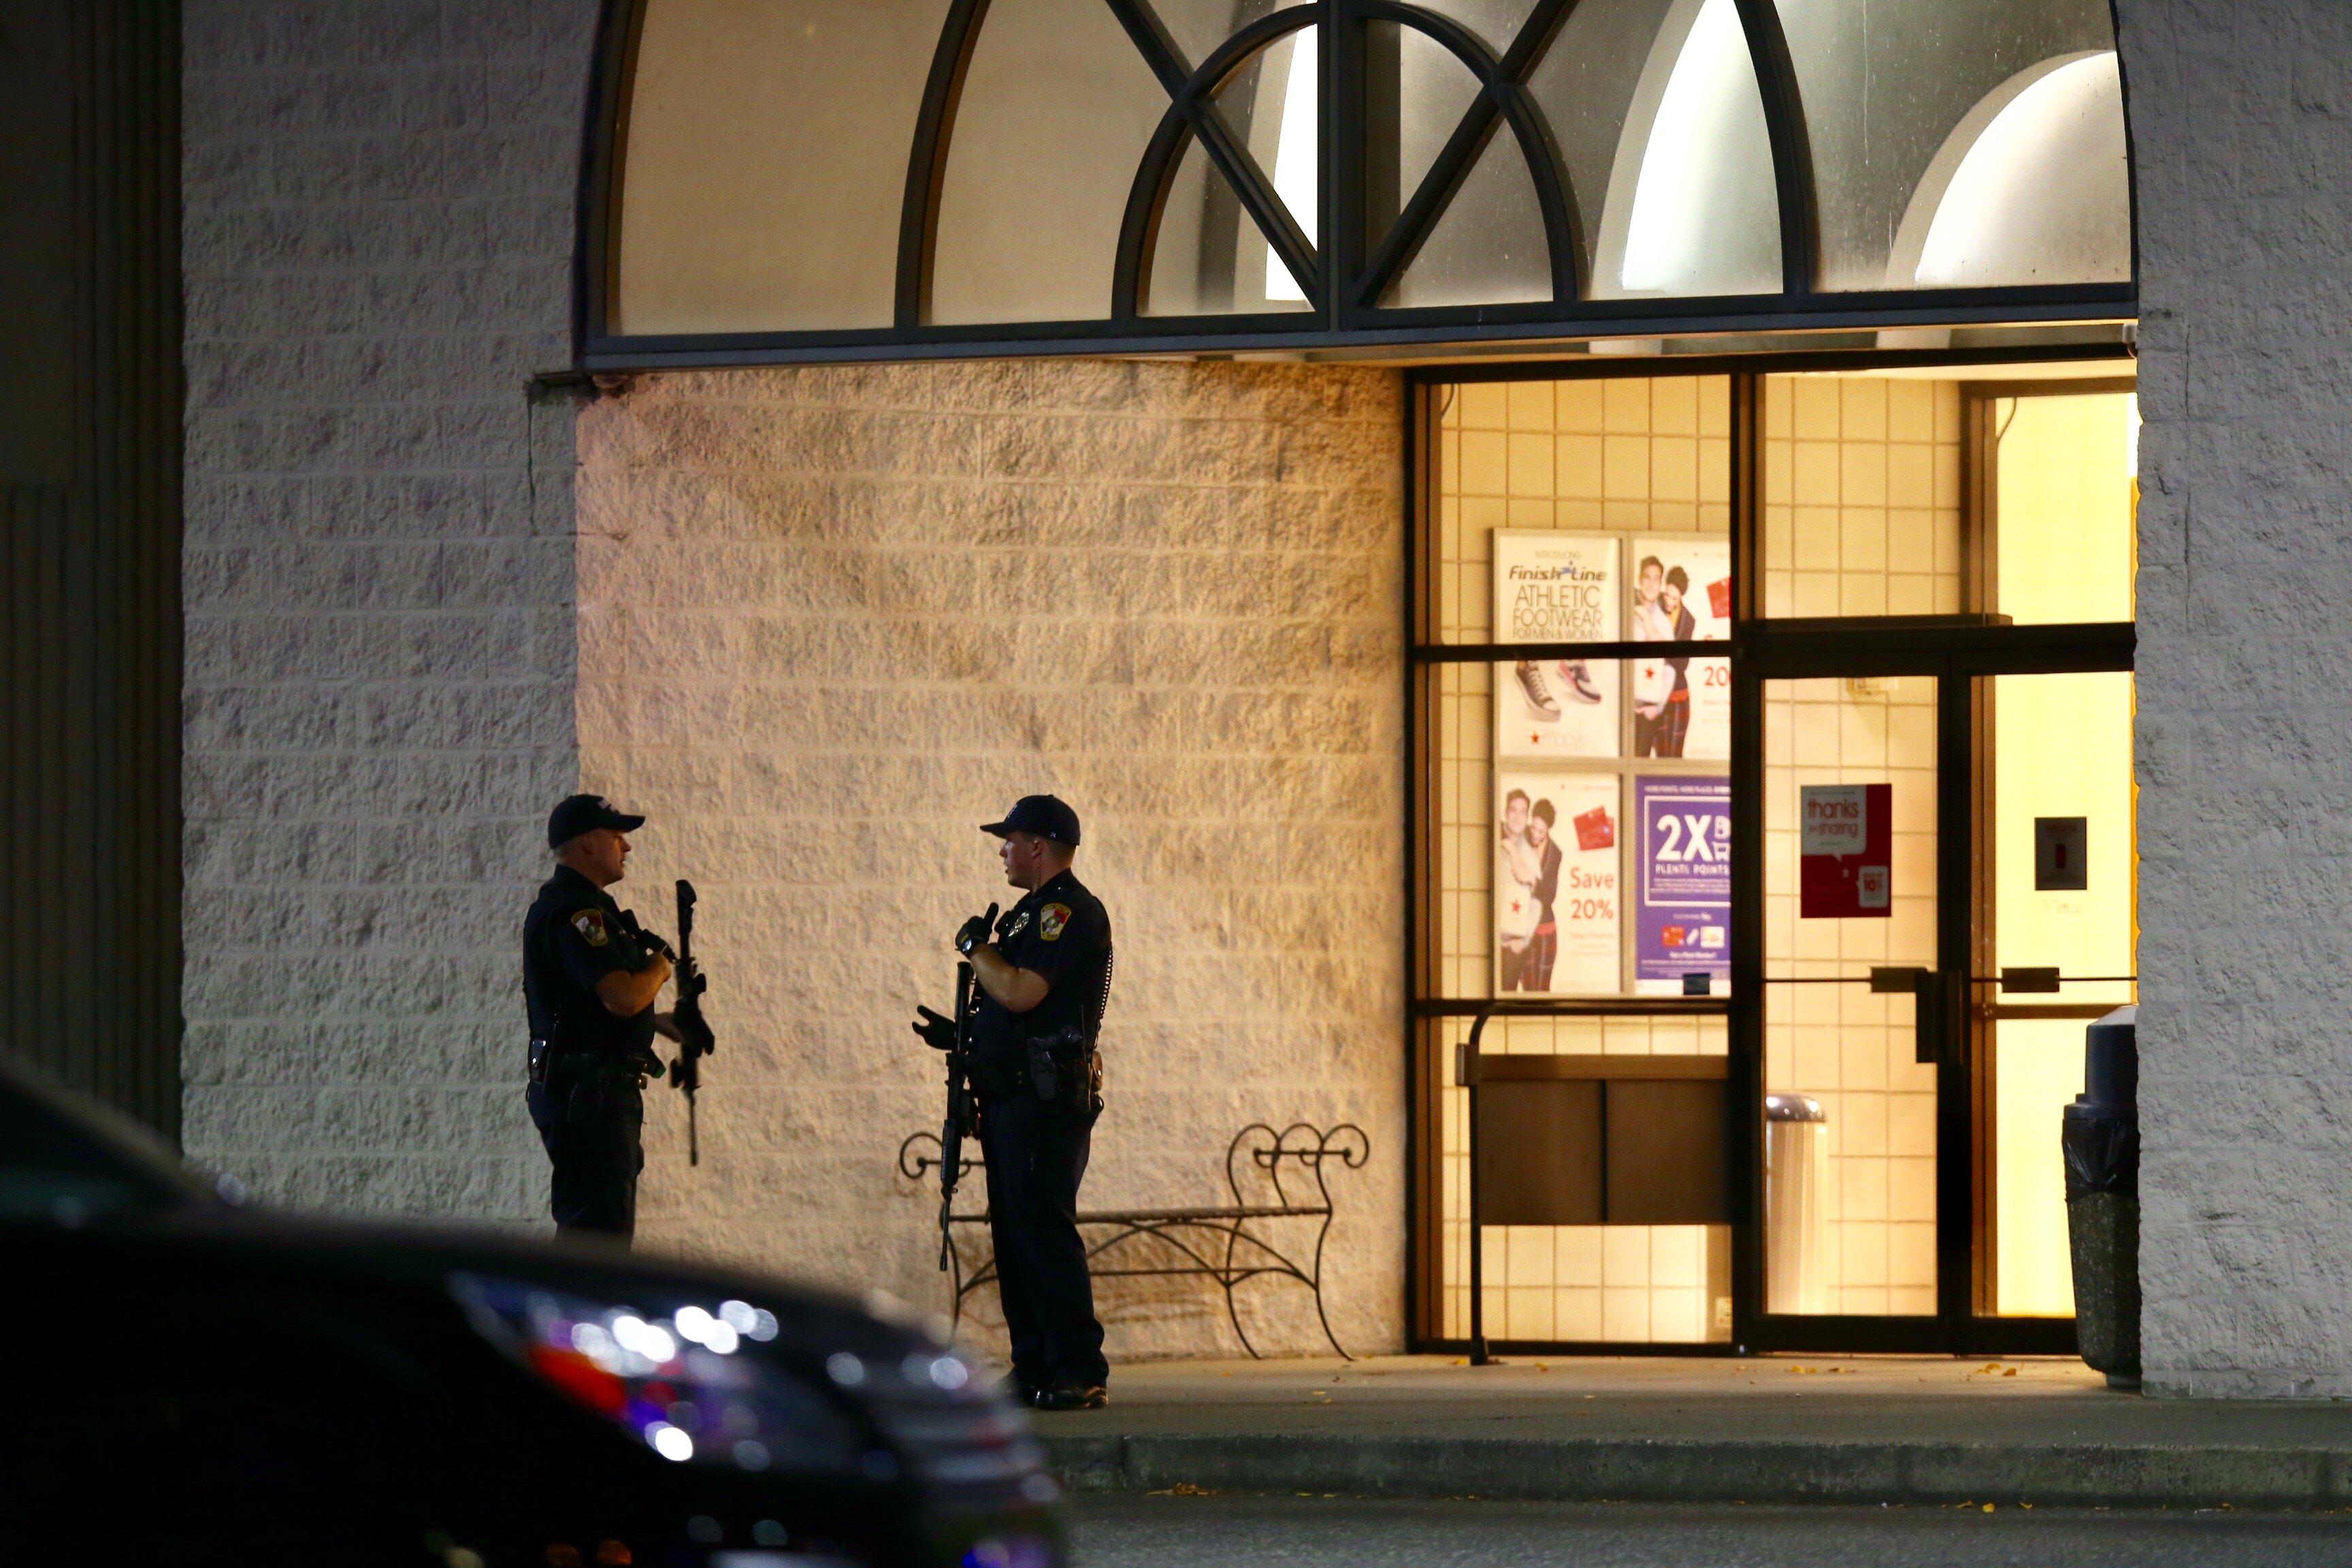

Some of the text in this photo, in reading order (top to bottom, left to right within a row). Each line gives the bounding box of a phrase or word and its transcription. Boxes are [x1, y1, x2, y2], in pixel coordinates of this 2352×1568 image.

[1509, 565, 1607, 581] Finish Line
[1514, 585, 1601, 608] ATHLETIC
[1512, 608, 1603, 627] FOOTWEAR
[1704, 666, 1731, 687] 20
[1808, 798, 1859, 819] thanks
[1655, 814, 1714, 862] 2X
[1570, 867, 1614, 889] Save
[1571, 898, 1614, 919] 20%
